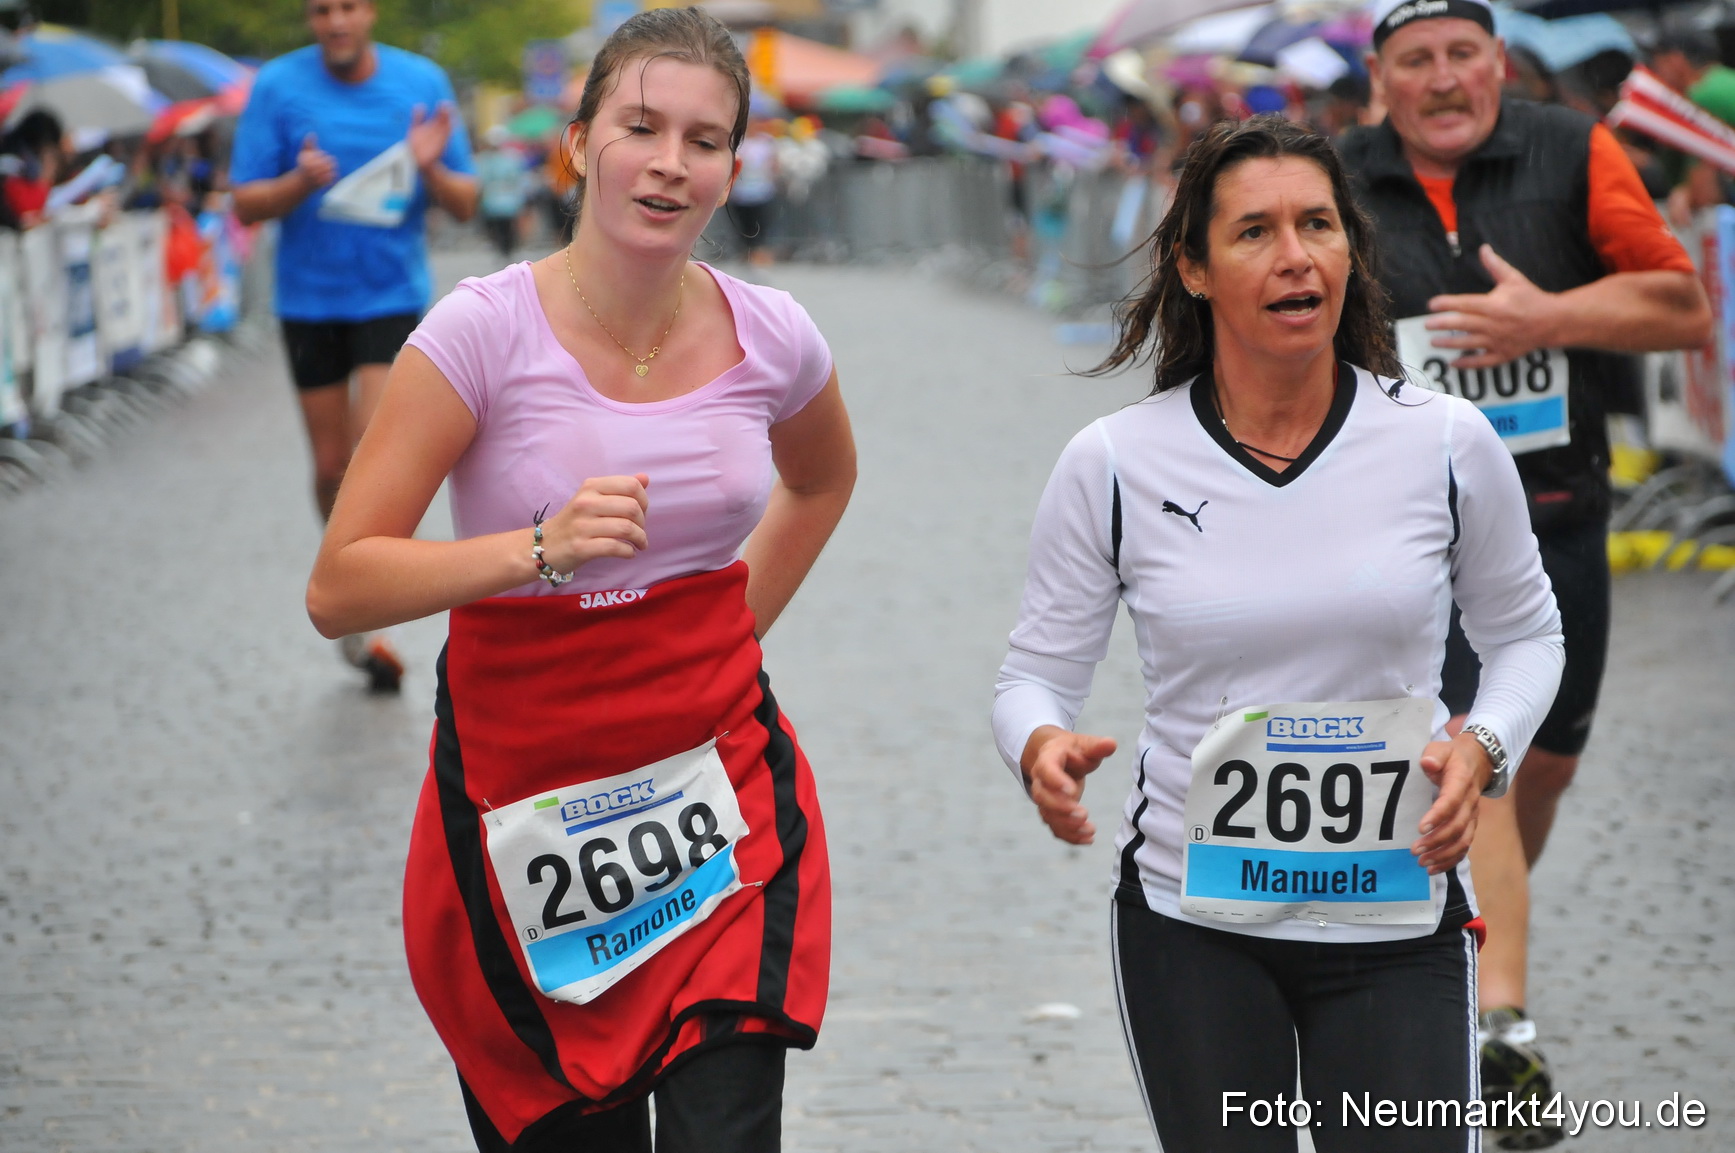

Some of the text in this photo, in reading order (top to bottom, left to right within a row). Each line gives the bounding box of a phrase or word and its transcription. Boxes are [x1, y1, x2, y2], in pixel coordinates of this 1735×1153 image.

[1423, 347, 1552, 401] 3008
[1267, 717, 1364, 739] BOCK
[561, 778, 656, 822] BOCK
[1212, 760, 1410, 844] 2697
[1194, 827, 1204, 841] D
[527, 802, 728, 930] 2698
[1241, 860, 1377, 894] Manuela
[526, 927, 538, 940] D
[586, 888, 696, 965] Ramone
